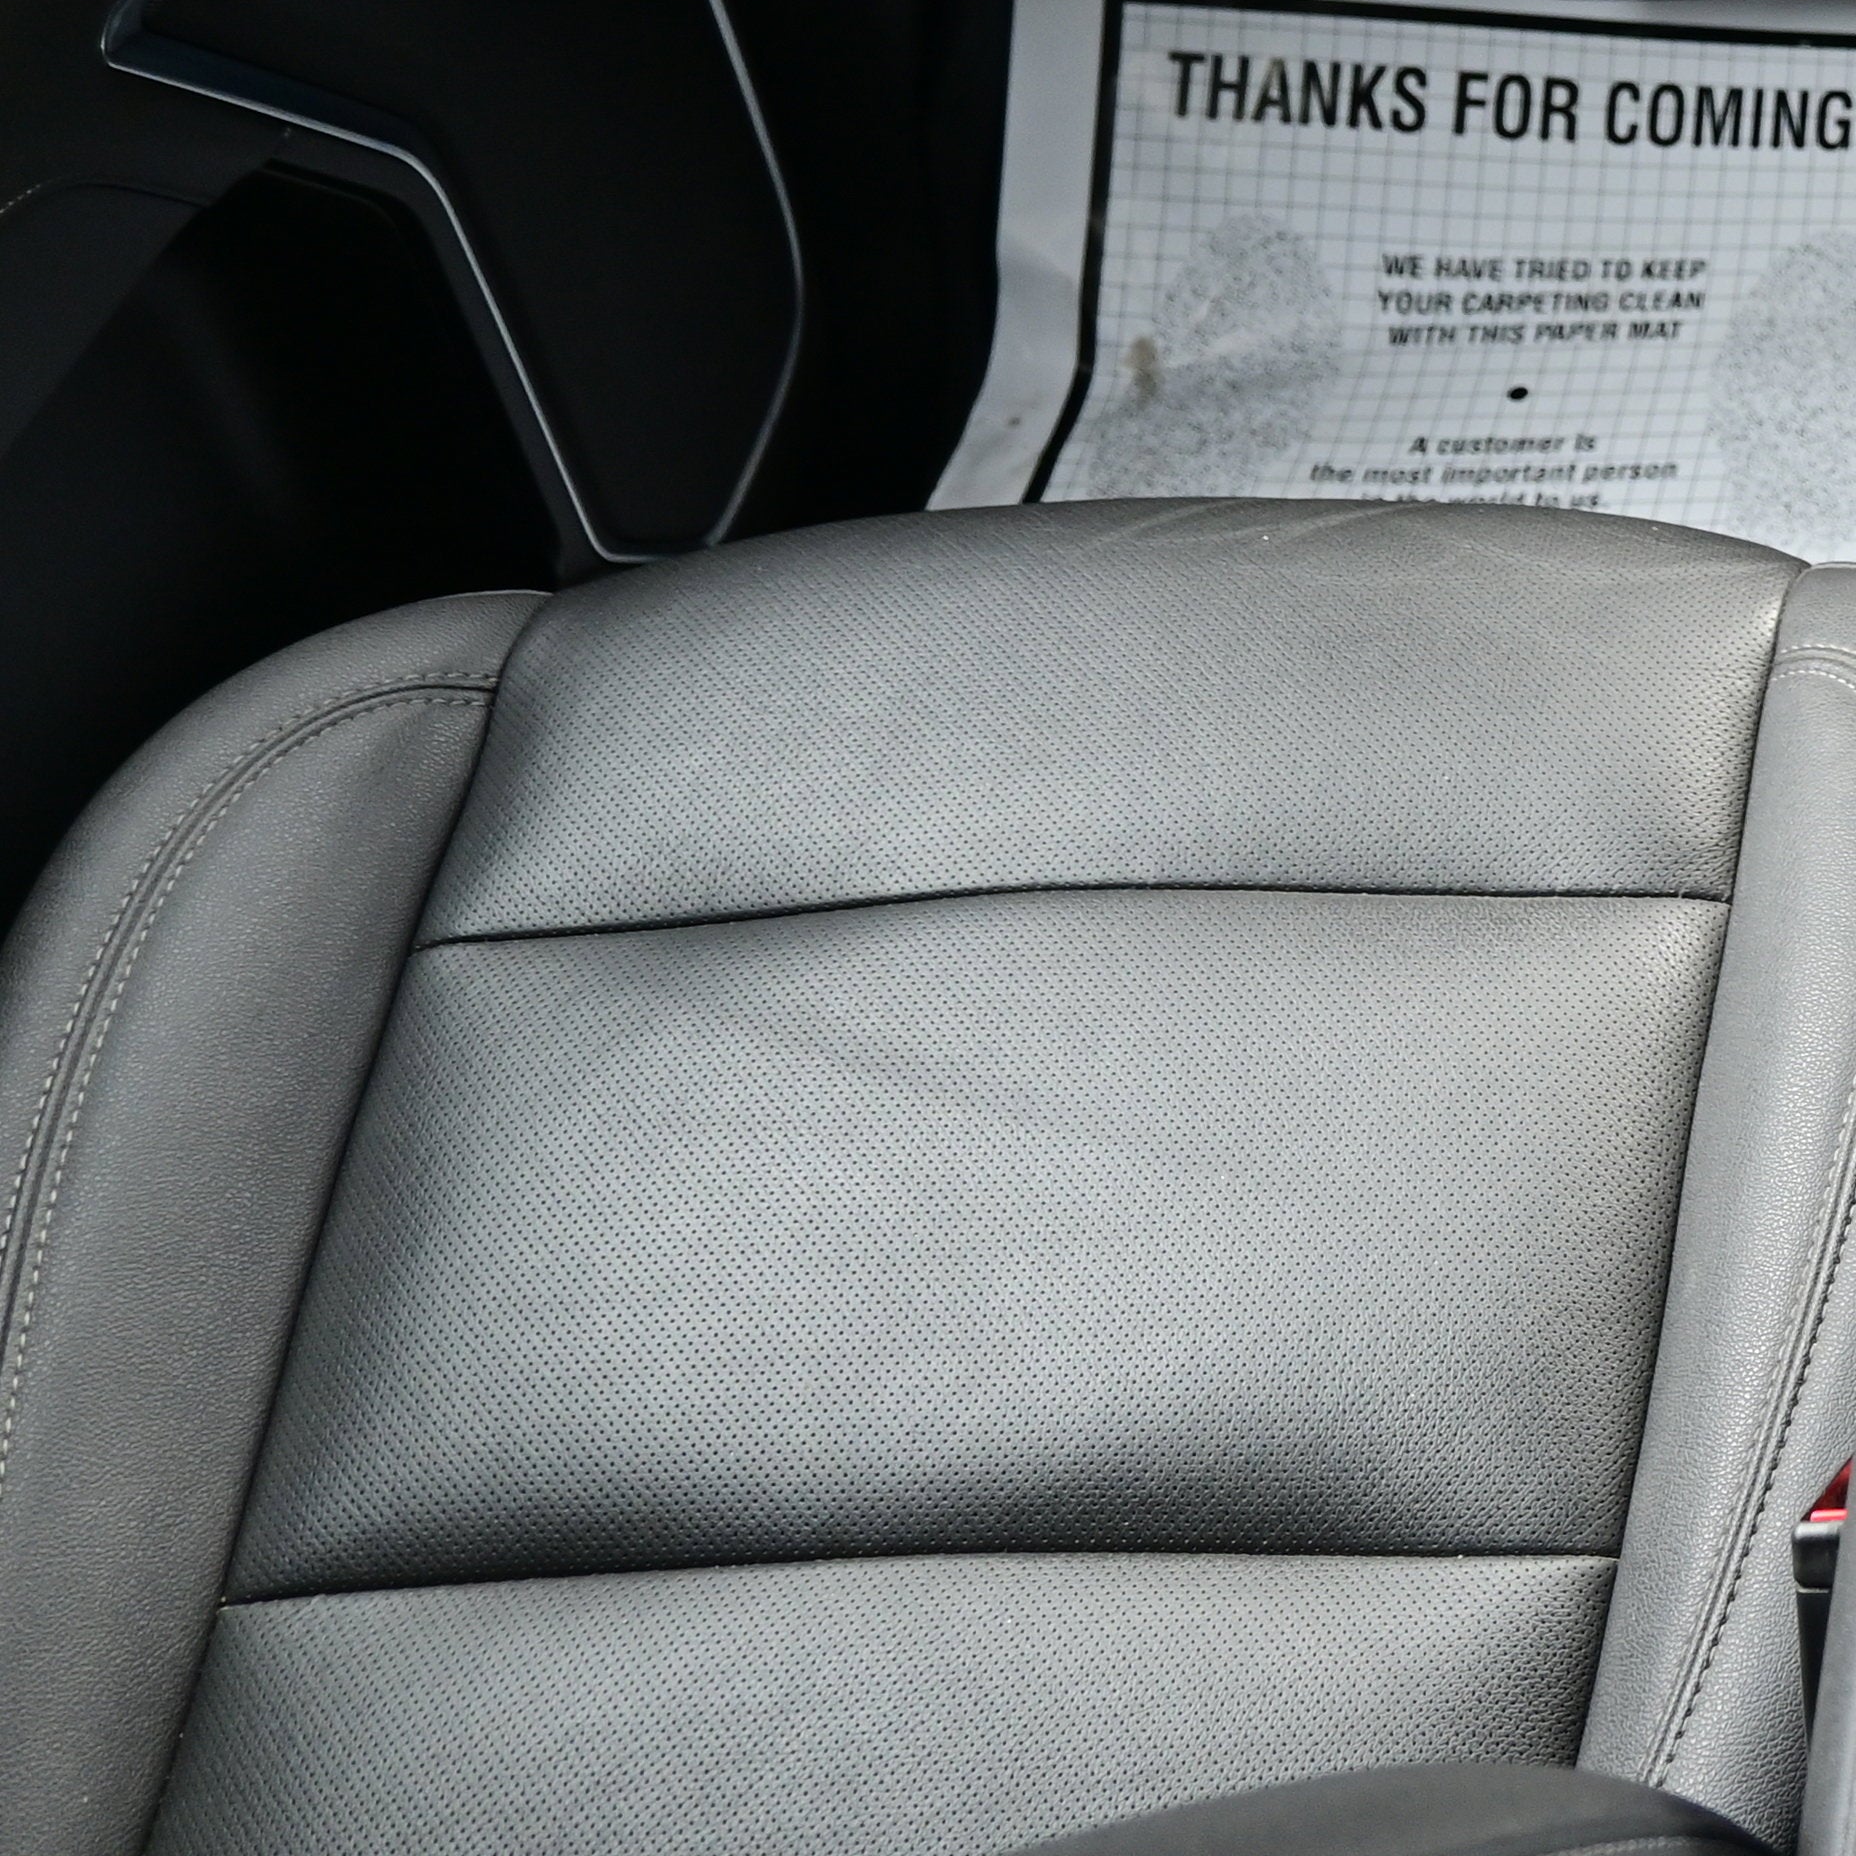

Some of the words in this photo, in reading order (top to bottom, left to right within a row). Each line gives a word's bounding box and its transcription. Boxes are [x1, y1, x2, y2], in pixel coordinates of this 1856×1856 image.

[1168, 50, 1427, 133] THANKS
[1452, 70, 1579, 143] FOR
[1605, 80, 1853, 150] COMING
[1381, 253, 1423, 279] WE
[1434, 255, 1501, 281] HAVE
[1514, 257, 1592, 281] TRIED
[1601, 257, 1634, 281] TO
[1640, 258, 1707, 281] KEEP
[1378, 289, 1453, 315] YOUR
[1461, 290, 1608, 315] CARPETING
[1618, 290, 1706, 312] CLEAN
[1388, 325, 1456, 345] WITH
[1467, 323, 1524, 345] THIS
[1533, 321, 1617, 343] PAPER
[1627, 321, 1683, 340] MAT
[1408, 435, 1427, 455] A
[1436, 436, 1565, 455] customer
[1574, 434, 1596, 452] is
[1310, 463, 1352, 483] the
[1363, 465, 1431, 484] most
[1441, 463, 1575, 485] important
[1582, 462, 1679, 484] person
